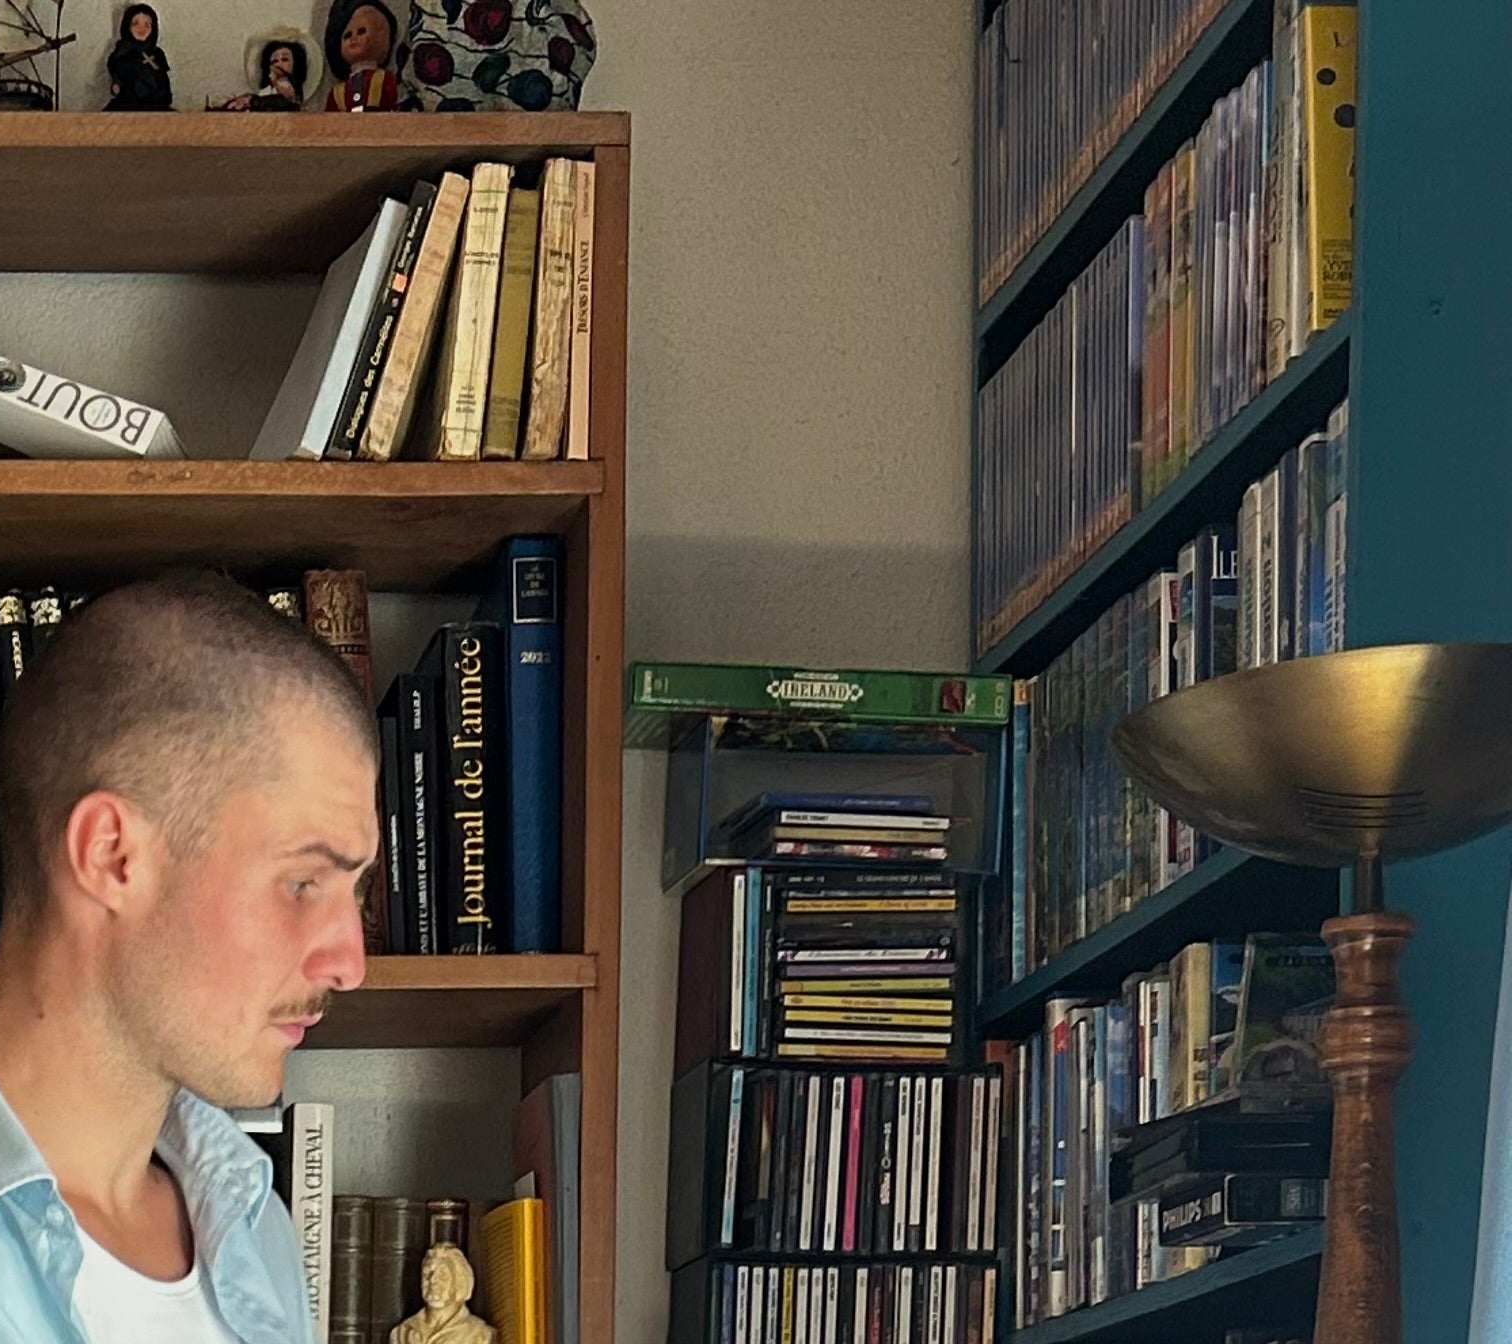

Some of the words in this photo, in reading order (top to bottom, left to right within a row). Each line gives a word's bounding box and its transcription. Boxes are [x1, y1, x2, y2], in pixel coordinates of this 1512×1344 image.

[452, 636, 484, 751] l'année
[781, 682, 848, 699] IRELAND
[454, 759, 485, 798] de
[457, 812, 493, 928] Journal
[304, 1123, 324, 1189] CHEVAL
